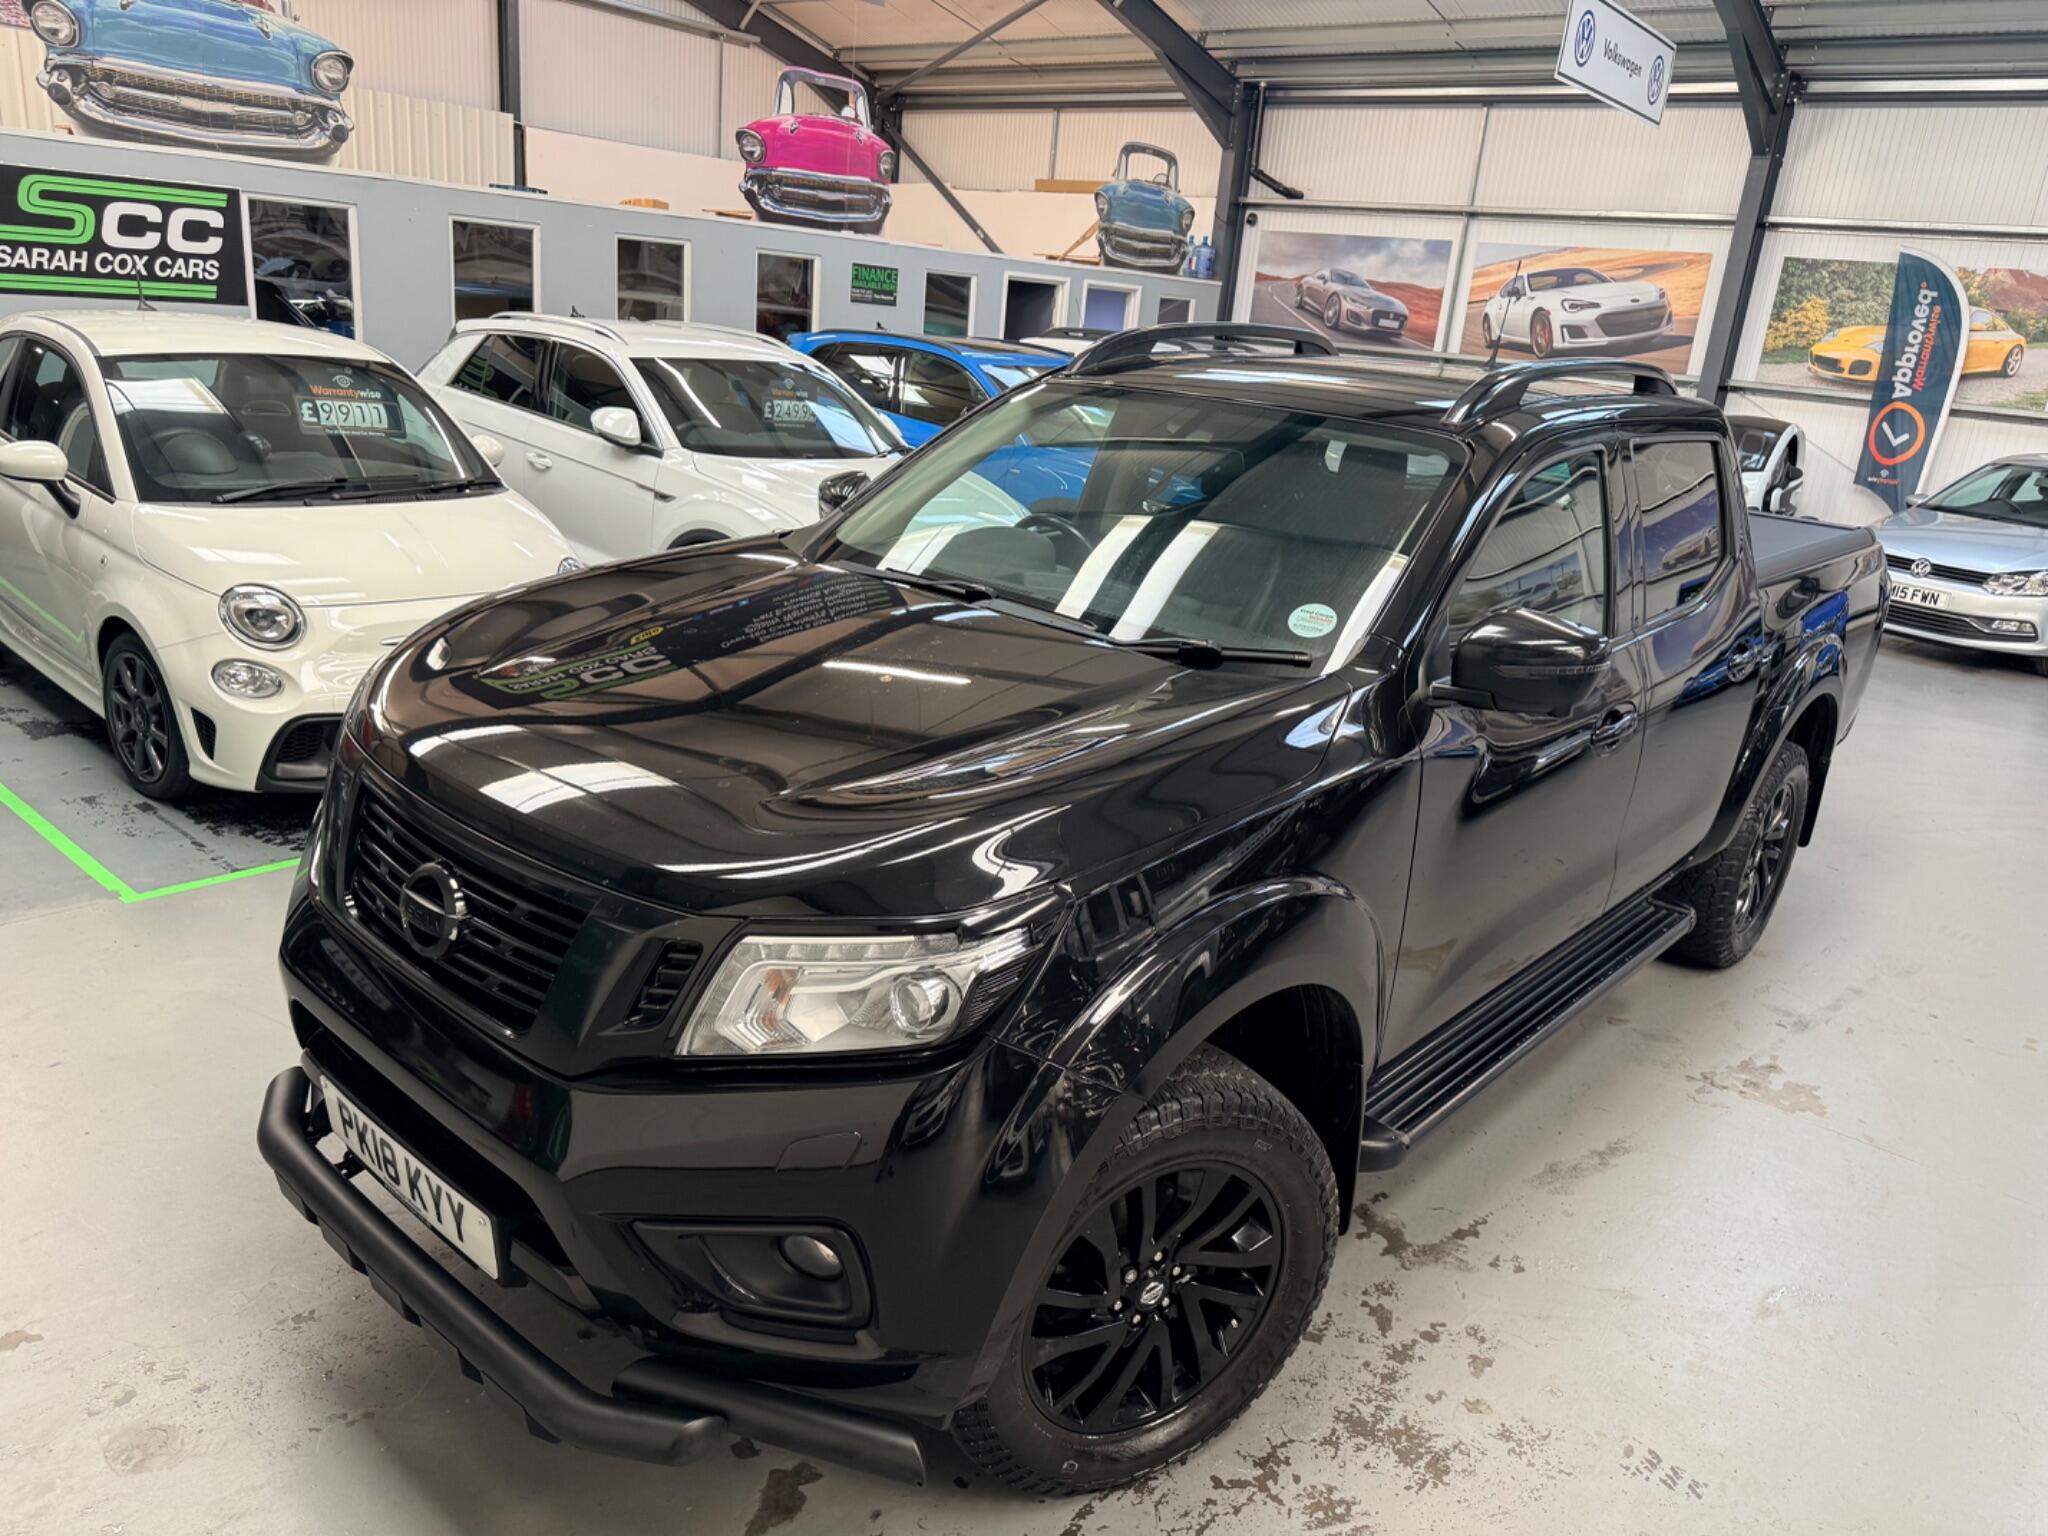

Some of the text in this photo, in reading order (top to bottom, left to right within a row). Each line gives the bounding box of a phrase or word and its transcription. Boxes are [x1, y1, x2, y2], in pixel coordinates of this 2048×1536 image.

[1603, 38, 1642, 78] Volkswagen
[12, 174, 227, 255] SCC
[0, 245, 220, 281] SARAH COX CARS
[852, 266, 897, 283] FINANCE
[310, 384, 381, 399] Warrantywise
[1911, 589, 1940, 606] FWN
[337, 1096, 400, 1186] PK18
[404, 1157, 464, 1243] KYY
